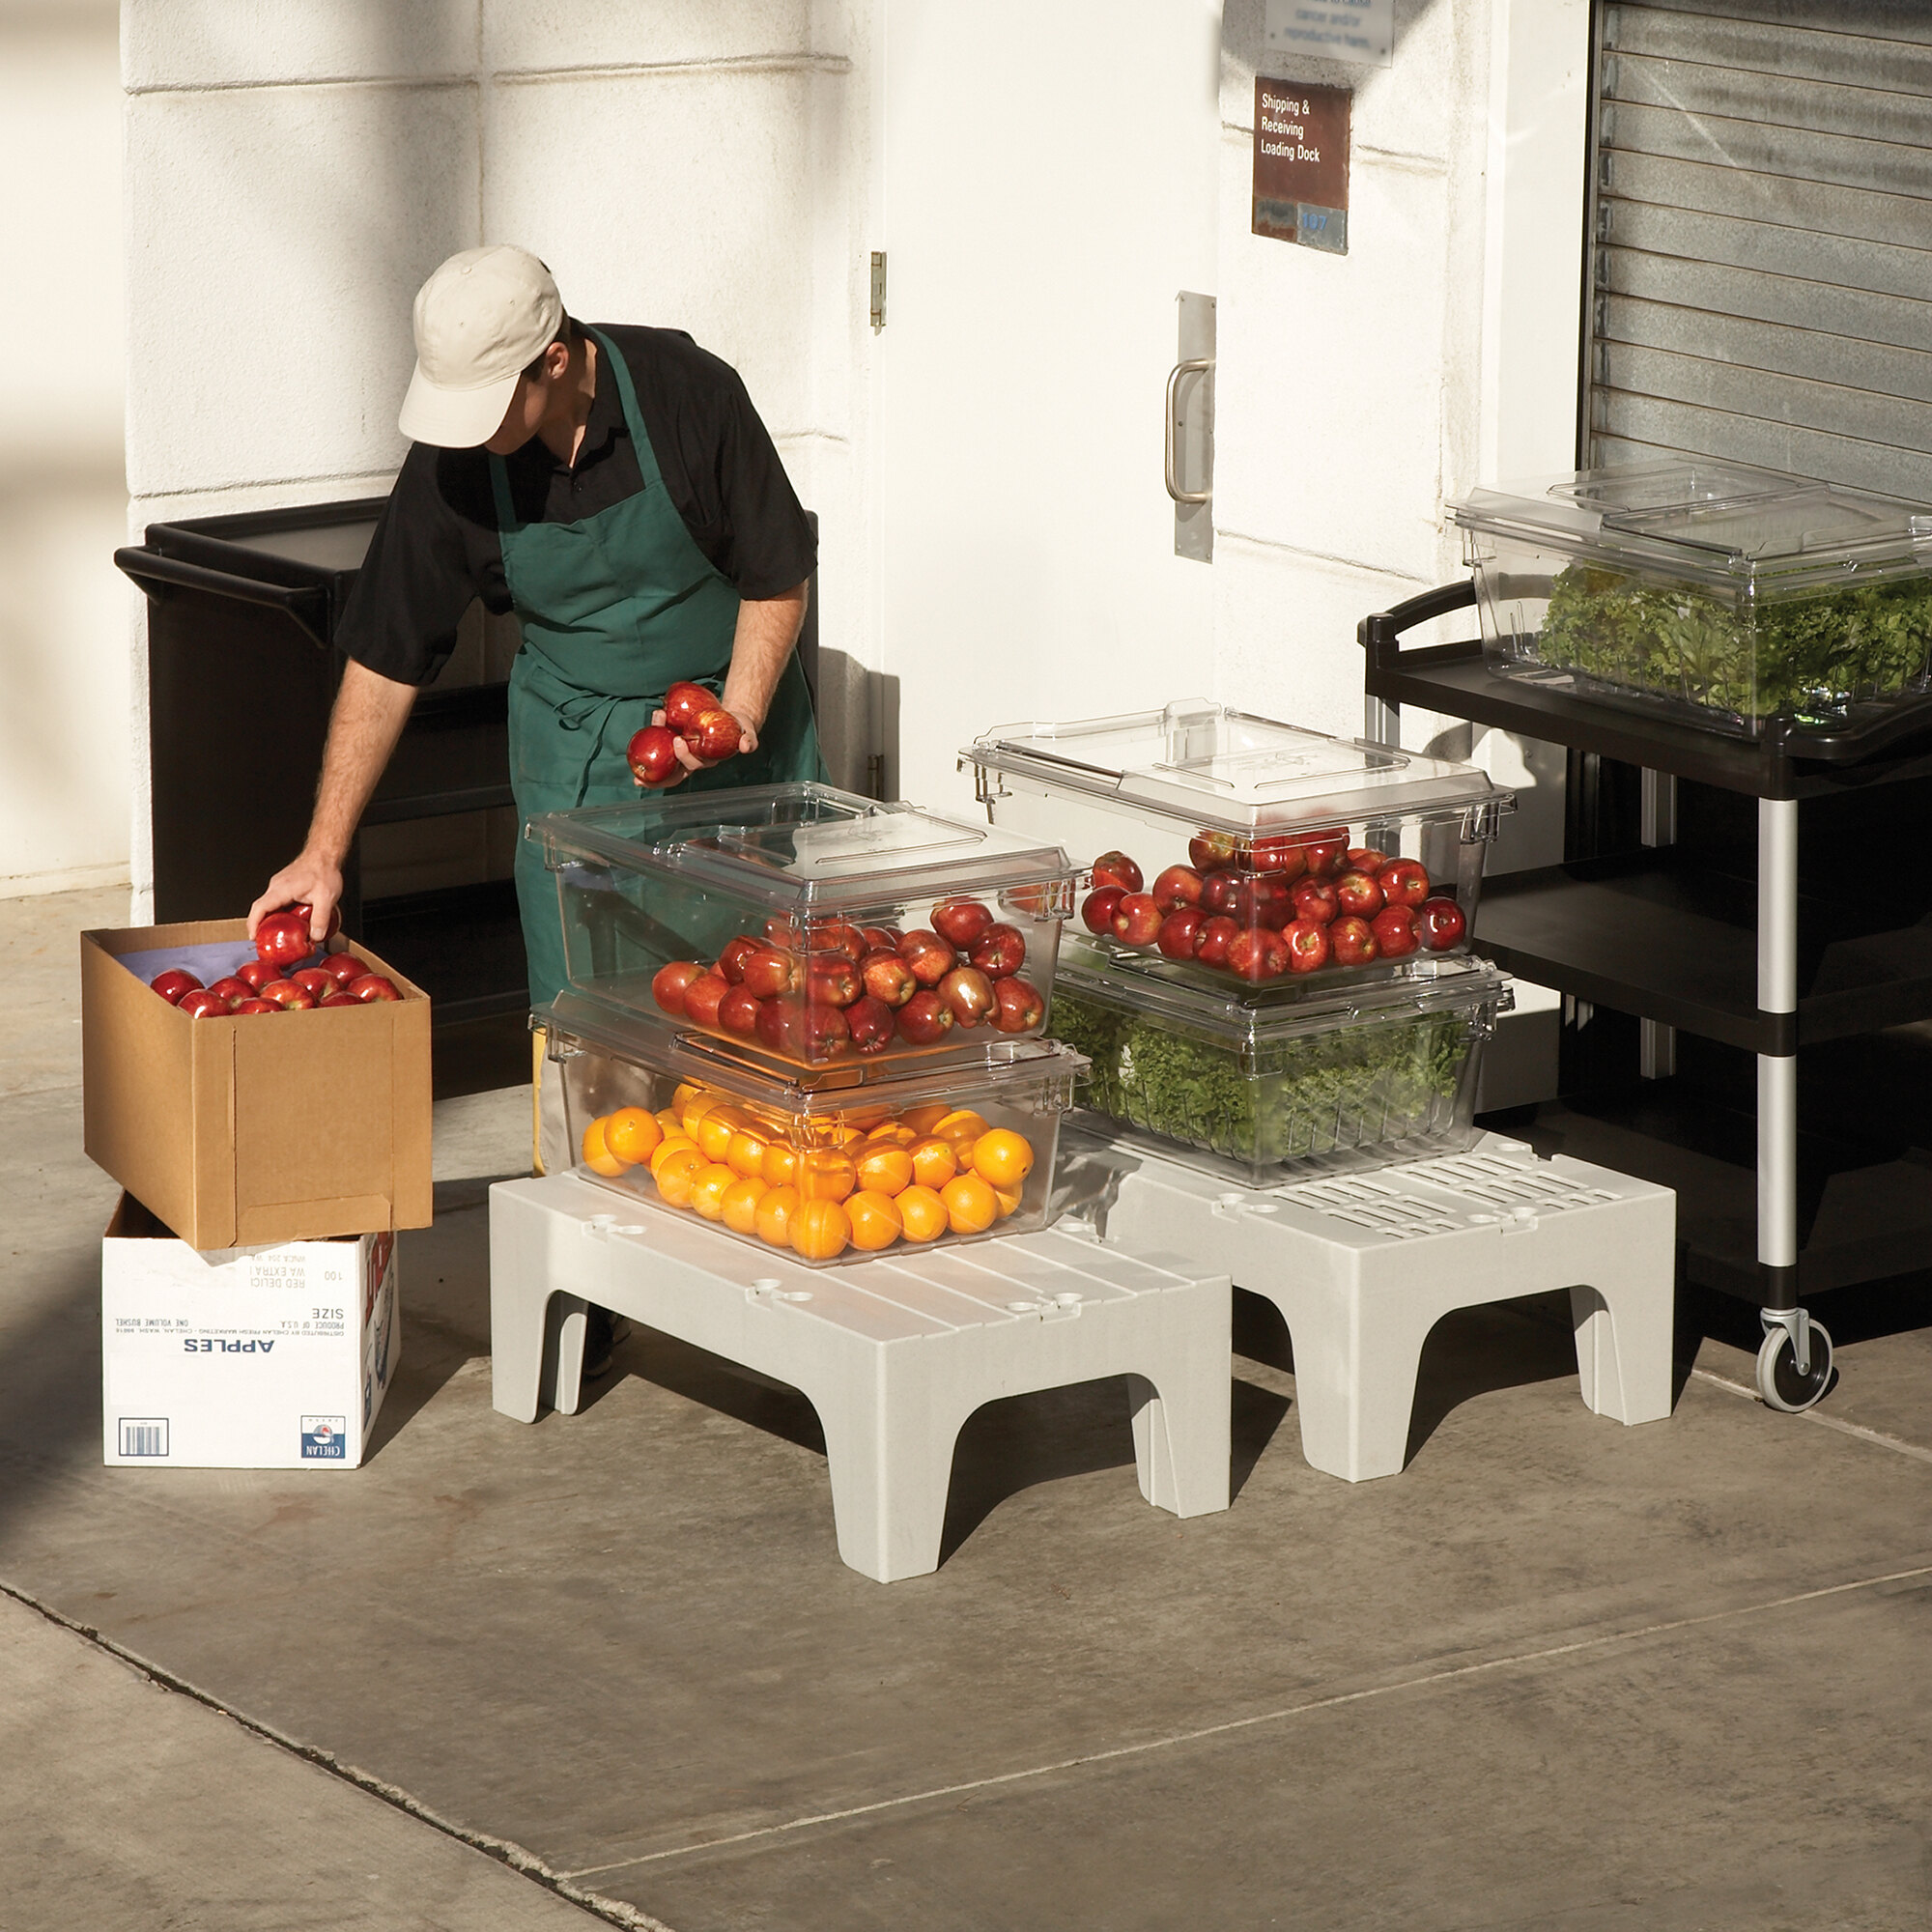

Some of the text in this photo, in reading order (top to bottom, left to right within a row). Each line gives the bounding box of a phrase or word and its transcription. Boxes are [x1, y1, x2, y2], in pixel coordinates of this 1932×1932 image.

[1262, 93, 1310, 117] Shipping &
[1262, 116, 1304, 140] Receiving
[1261, 139, 1321, 163] Loading Dock
[1301, 212, 1327, 231] 107
[255, 1266, 287, 1276] EXTRA
[290, 1267, 305, 1277] WA
[324, 1270, 342, 1281] 100
[285, 1278, 305, 1289] RED
[312, 1308, 344, 1320] SIZE
[116, 1319, 141, 1327] BUSHEL
[176, 1319, 188, 1327] ONE
[184, 1339, 275, 1353] APPLES
[306, 1445, 340, 1457] CHELAN
